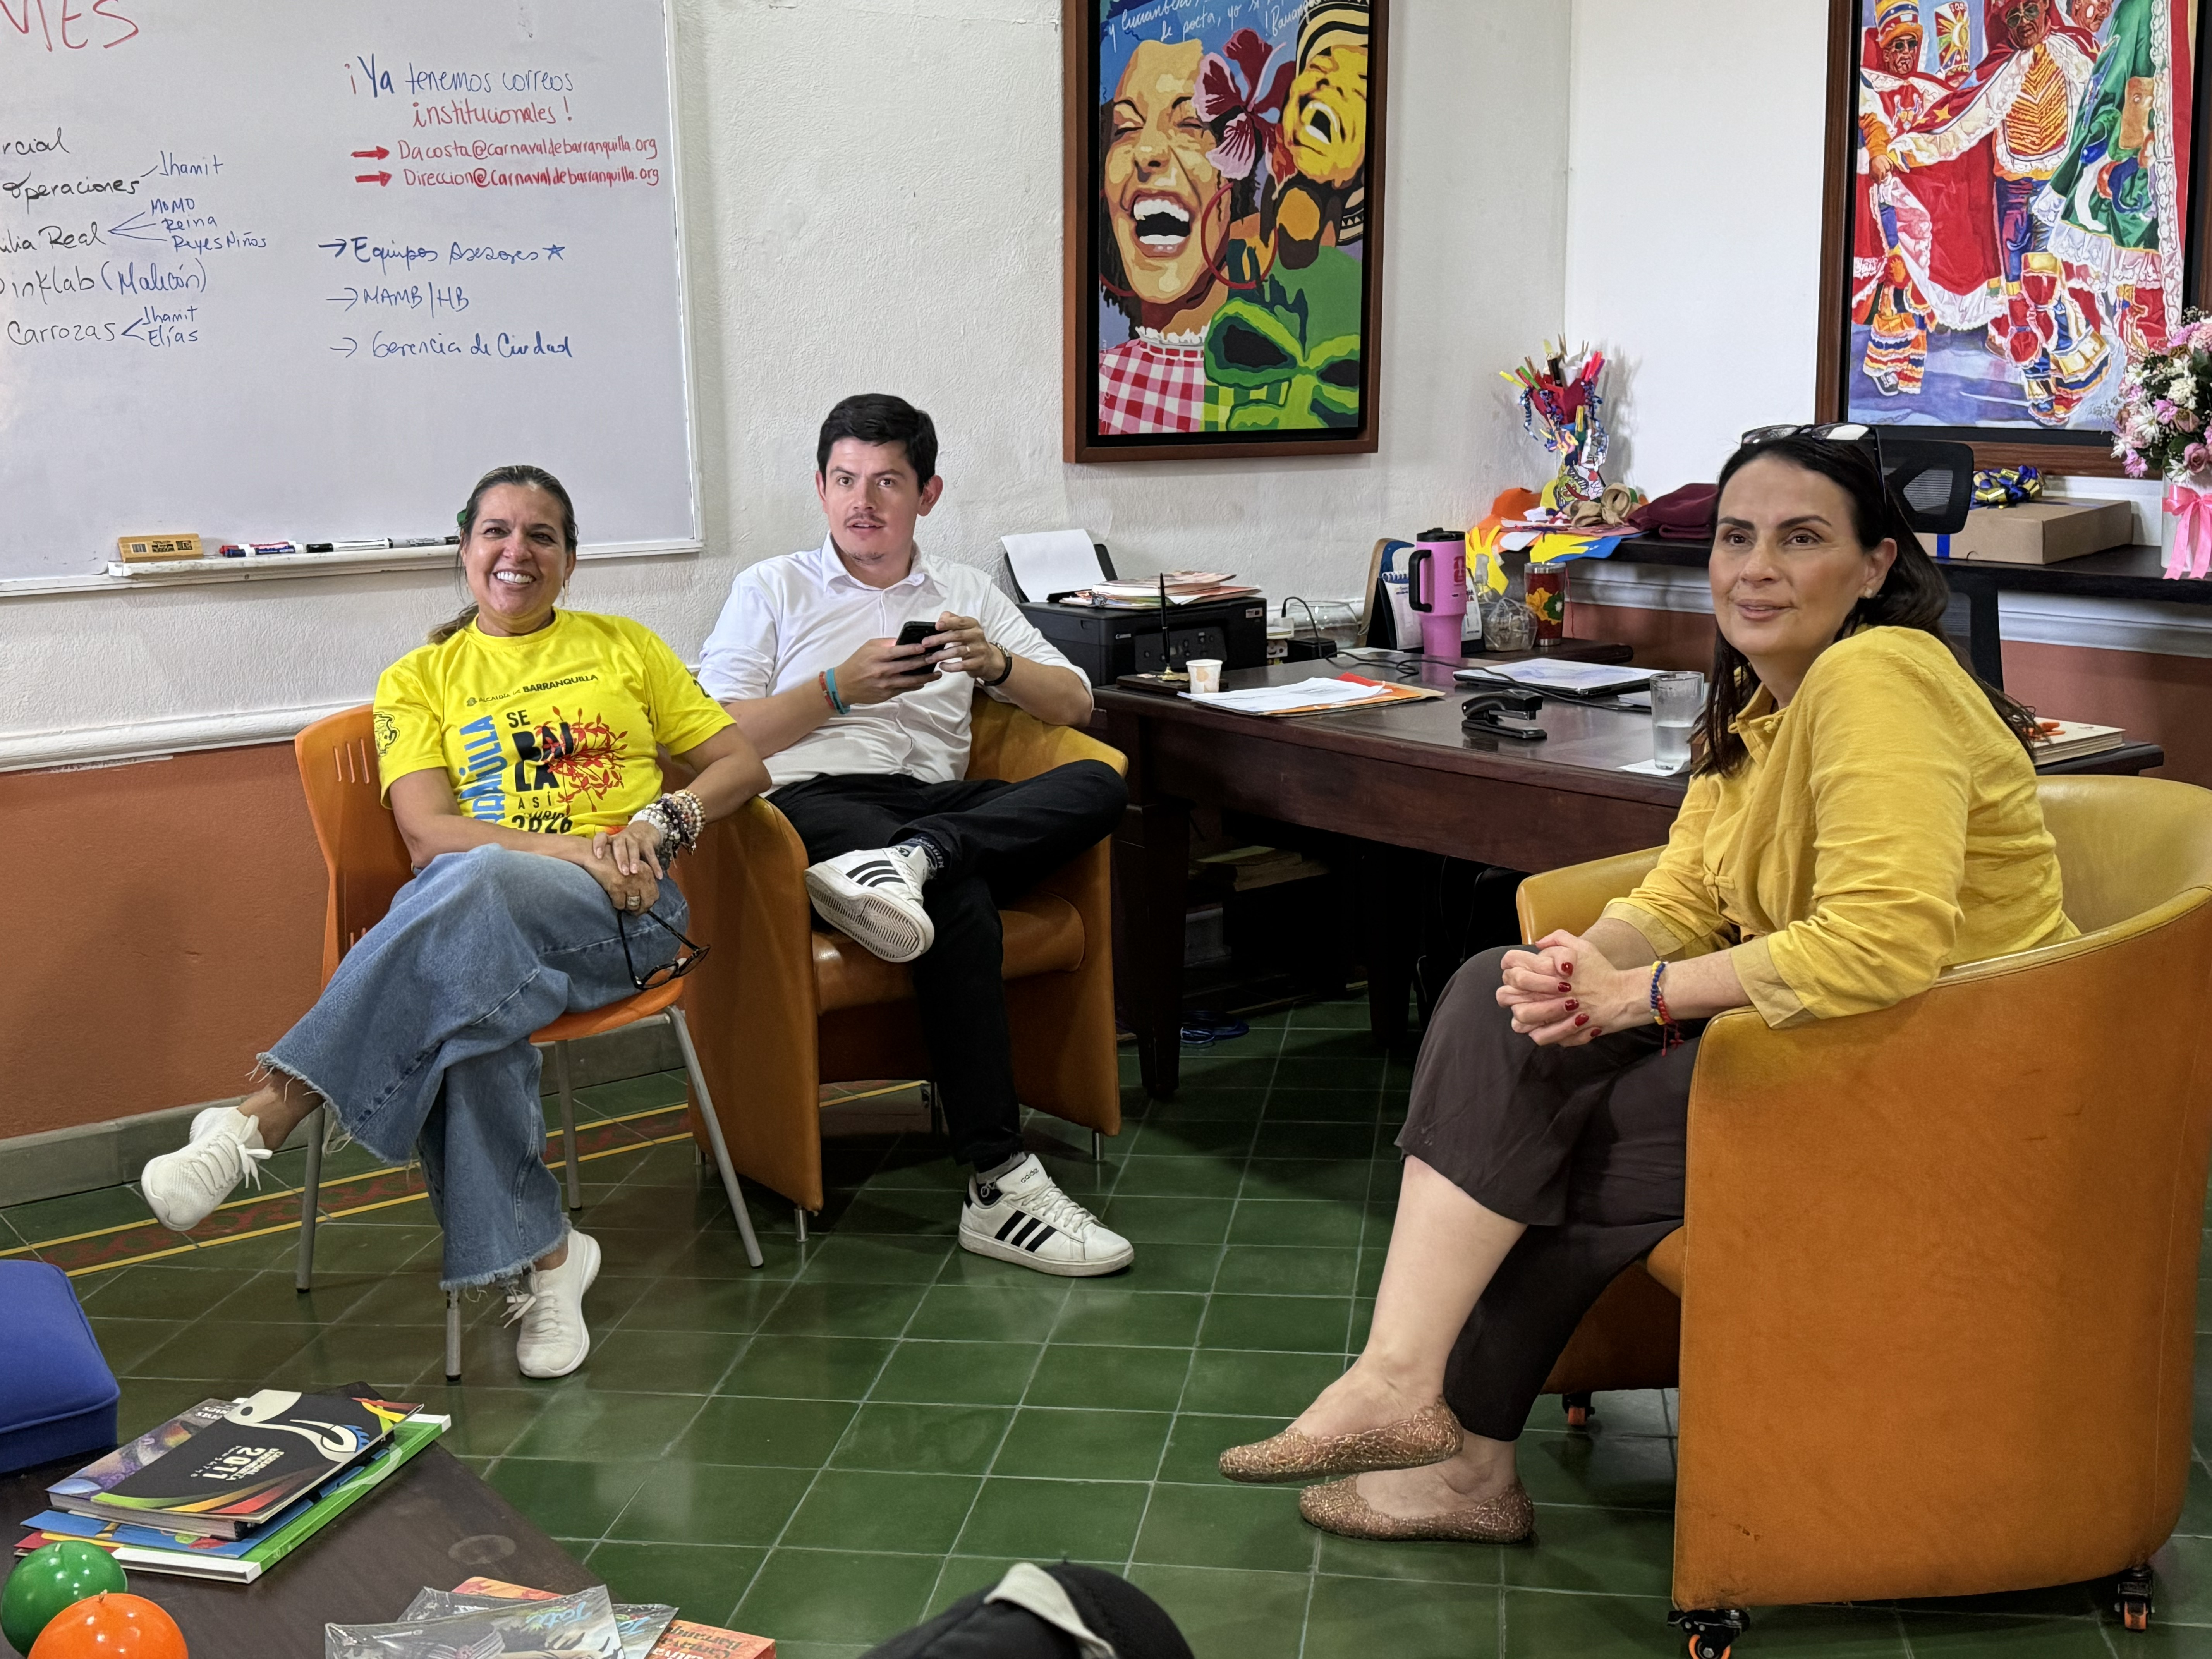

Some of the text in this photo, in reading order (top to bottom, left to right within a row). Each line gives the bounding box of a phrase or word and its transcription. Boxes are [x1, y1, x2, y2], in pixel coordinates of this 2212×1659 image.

[405, 62, 492, 95] tenemos
[503, 69, 574, 93] correos
[38, 221, 107, 250] Real
[161, 215, 218, 233] Reina
[172, 230, 267, 253] Reyes Niños
[350, 237, 539, 275] Equipos Asesores
[7, 319, 117, 346] Carrozas
[148, 326, 198, 347] Elías
[373, 330, 573, 358] Gerencia de Ciudad
[522, 674, 599, 693] BARRANQUILLA
[506, 709, 531, 728] SE
[514, 760, 560, 792] LA
[517, 791, 551, 810] ASÍ
[202, 1447, 266, 1479] 2011
